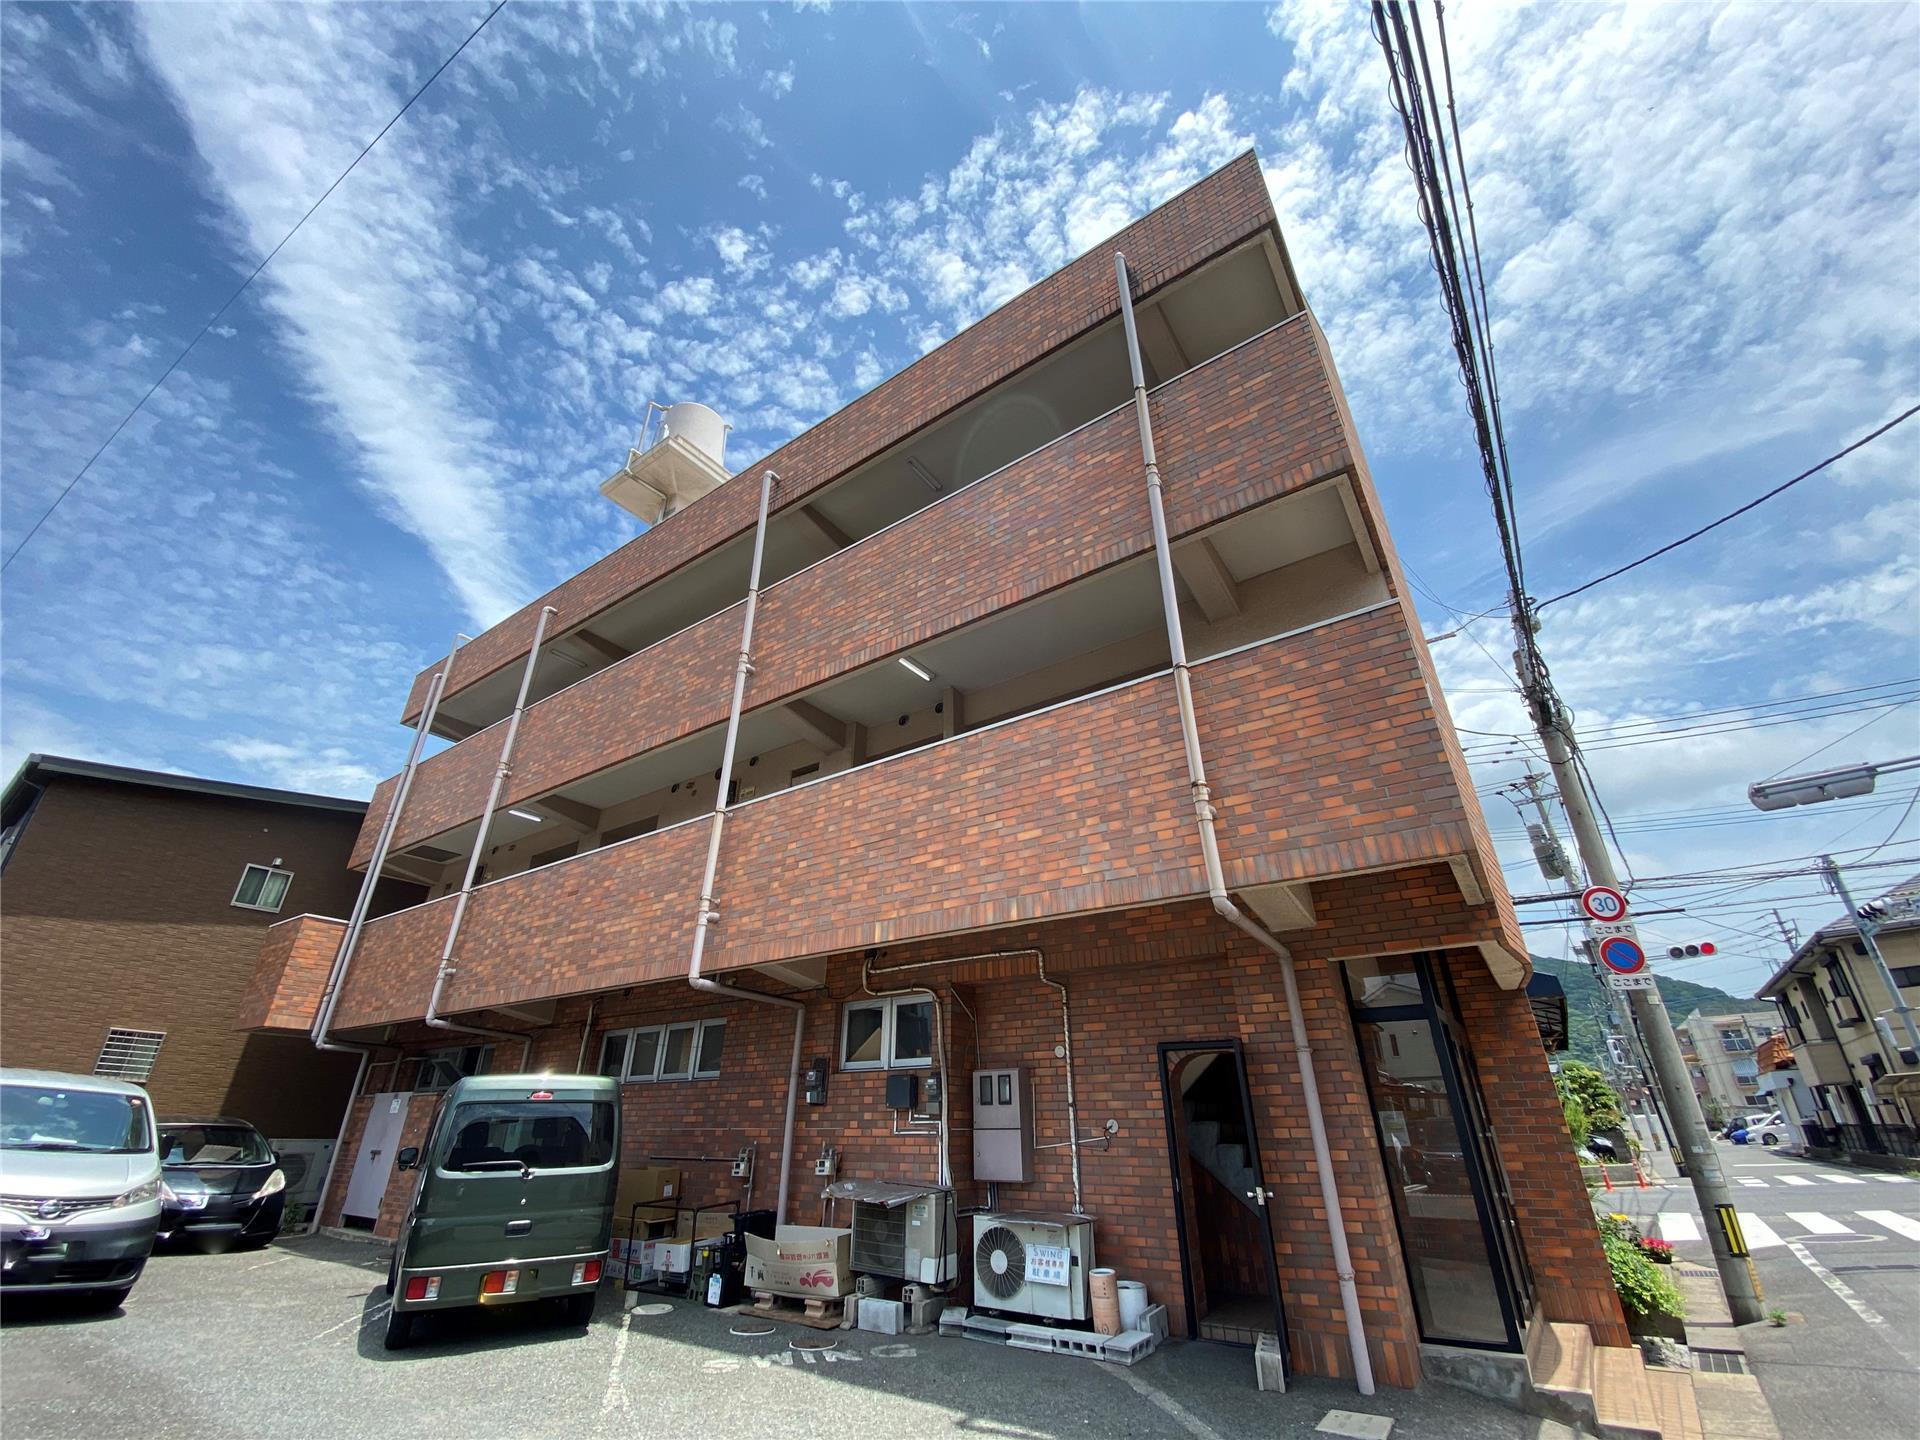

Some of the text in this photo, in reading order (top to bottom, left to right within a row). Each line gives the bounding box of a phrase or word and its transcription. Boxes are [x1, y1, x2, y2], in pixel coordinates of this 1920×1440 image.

[1592, 896, 1616, 912] 30
[1595, 925, 1632, 935] ここまで
[1613, 977, 1651, 987] ここまで
[1033, 1247, 1062, 1259] SWING
